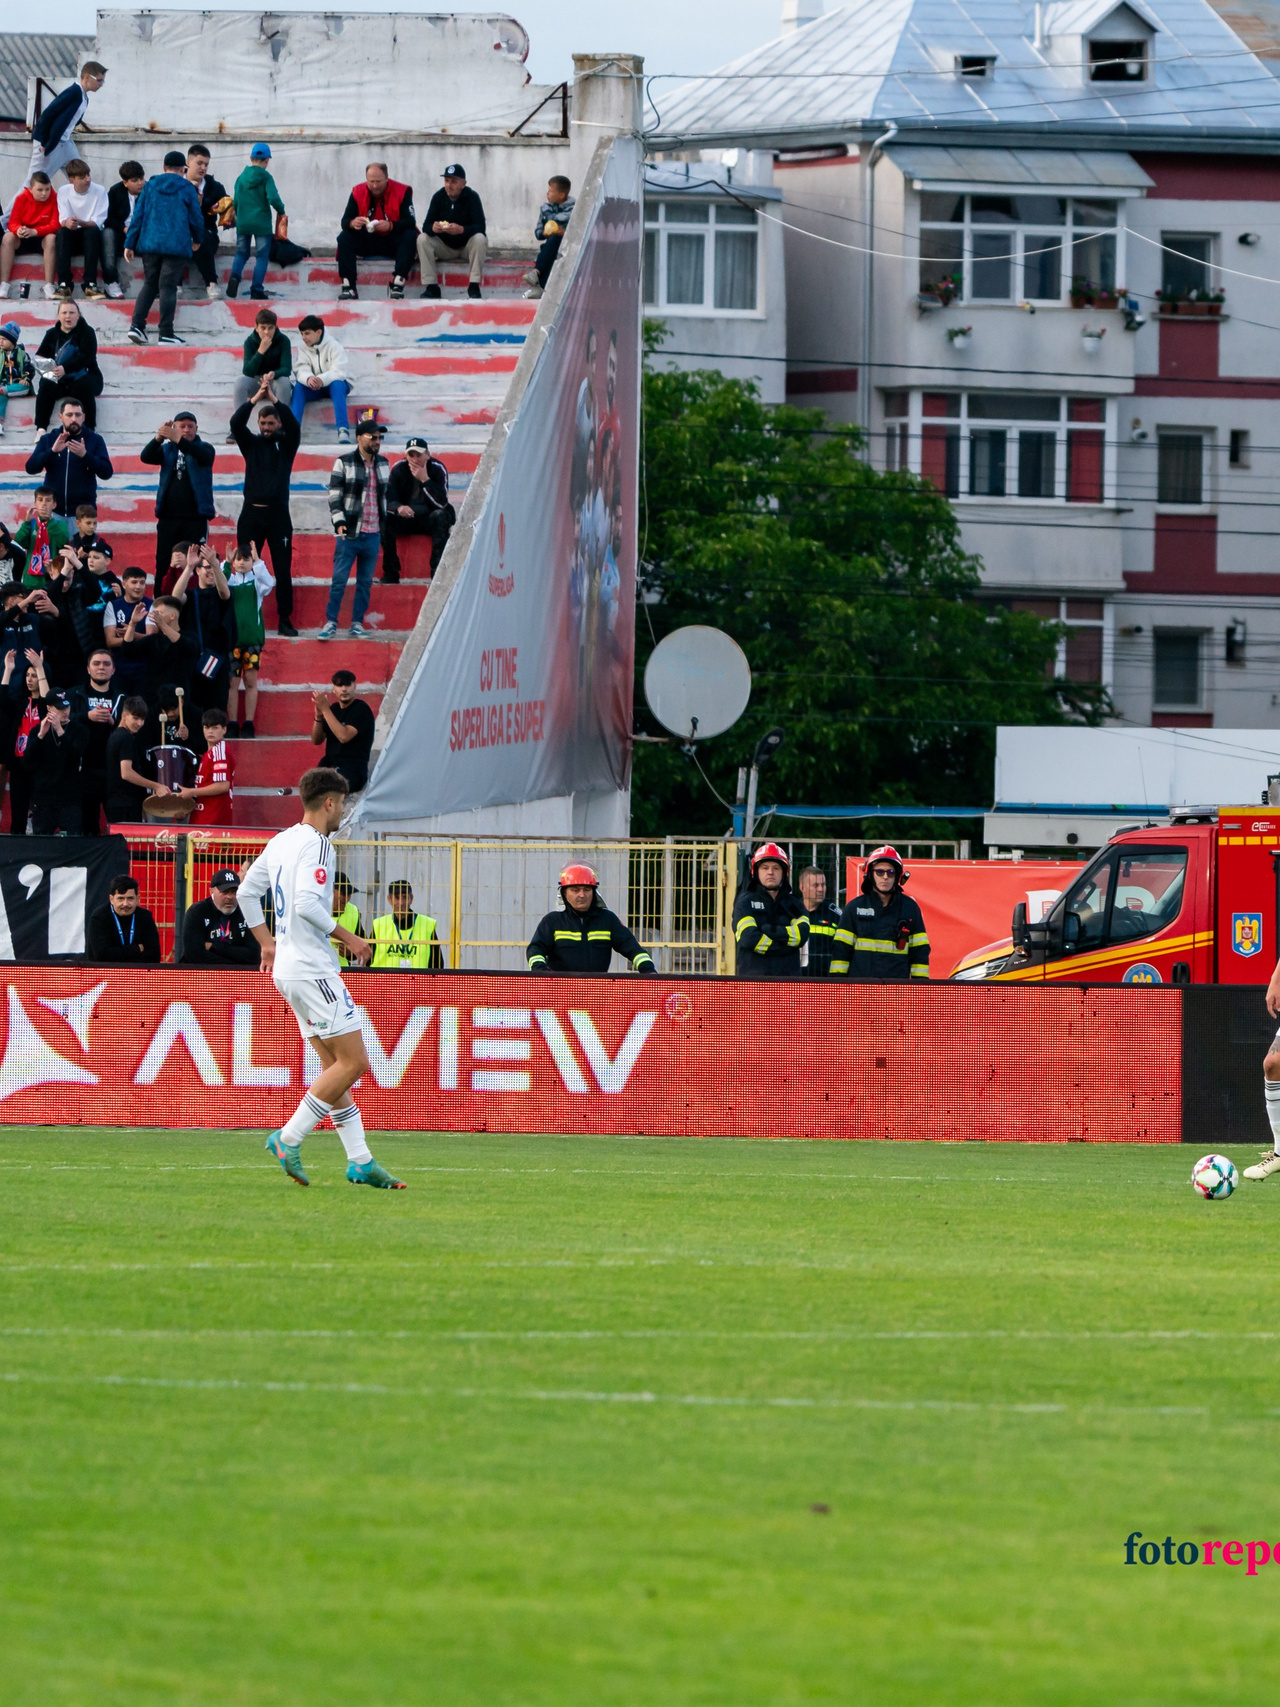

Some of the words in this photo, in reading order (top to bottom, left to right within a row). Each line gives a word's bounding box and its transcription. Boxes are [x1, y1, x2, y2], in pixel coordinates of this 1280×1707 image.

[480, 649, 494, 692] CU
[495, 648, 520, 698] TINE,
[450, 704, 504, 752] SUPERLIGA
[506, 703, 513, 744] E
